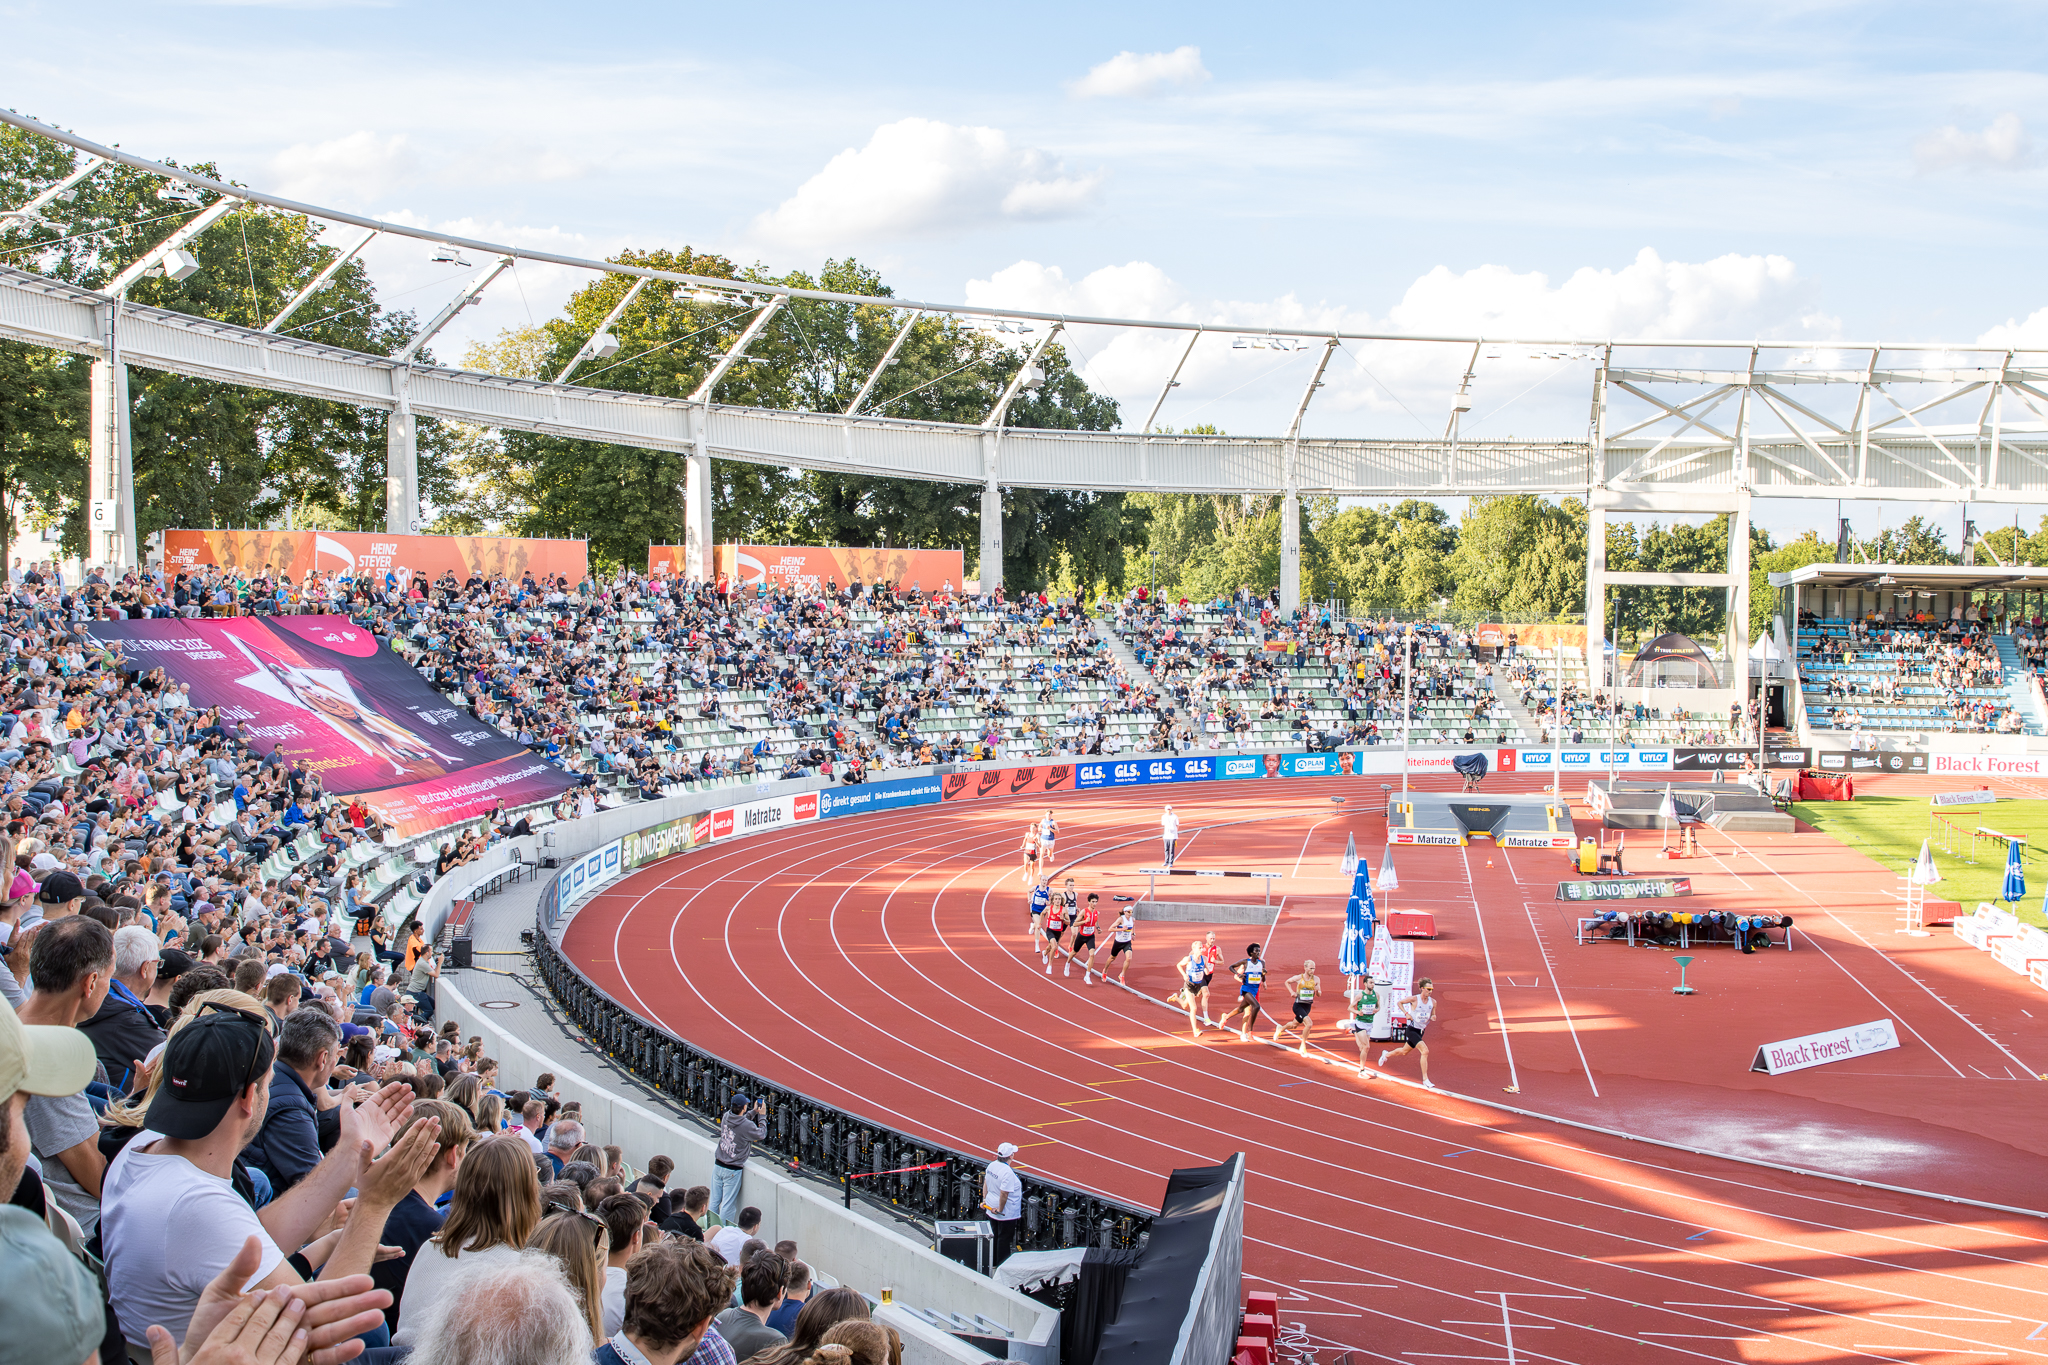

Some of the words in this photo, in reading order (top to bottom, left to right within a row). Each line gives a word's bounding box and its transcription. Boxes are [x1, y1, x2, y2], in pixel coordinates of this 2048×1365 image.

[95, 508, 103, 521] G
[410, 520, 418, 531] G
[371, 543, 398, 555] HEINZ
[993, 540, 1000, 548] H
[179, 548, 200, 557] HEINZ
[1290, 547, 1297, 555] H
[170, 556, 195, 564] STEYER
[358, 555, 392, 567] STEYER
[780, 556, 807, 566] HEINZ
[768, 565, 801, 575] STEYER
[139, 638, 182, 652] FINALS
[178, 638, 213, 650] 2025
[1525, 754, 1549, 763] HYLO
[1564, 754, 1588, 763] HYLO
[1643, 753, 1666, 762] HYLO
[1697, 753, 1722, 764] WGV
[1935, 756, 1982, 771] Black
[1987, 757, 2040, 773] Forest
[982, 771, 1001, 785] RUN
[1015, 768, 1035, 782] RUN
[1050, 765, 1070, 779] RUN
[949, 774, 968, 788] RUN
[415, 789, 453, 805] Deutsche
[874, 792, 882, 800] Die
[882, 789, 911, 799] Krankenkasse
[911, 787, 924, 796] direkt
[1940, 794, 1956, 805] Black
[1957, 794, 1975, 803] Forest
[832, 795, 849, 808] direkt
[850, 792, 871, 807] gesund
[744, 806, 782, 828] Matratze
[633, 822, 692, 861] BUNDESWEHR
[1417, 835, 1457, 845] Matratze
[1508, 837, 1548, 847] Matratze
[1585, 882, 1669, 897] BUNDESWEHR
[1770, 1044, 1811, 1069] Black
[1809, 1036, 1853, 1061] Forest
